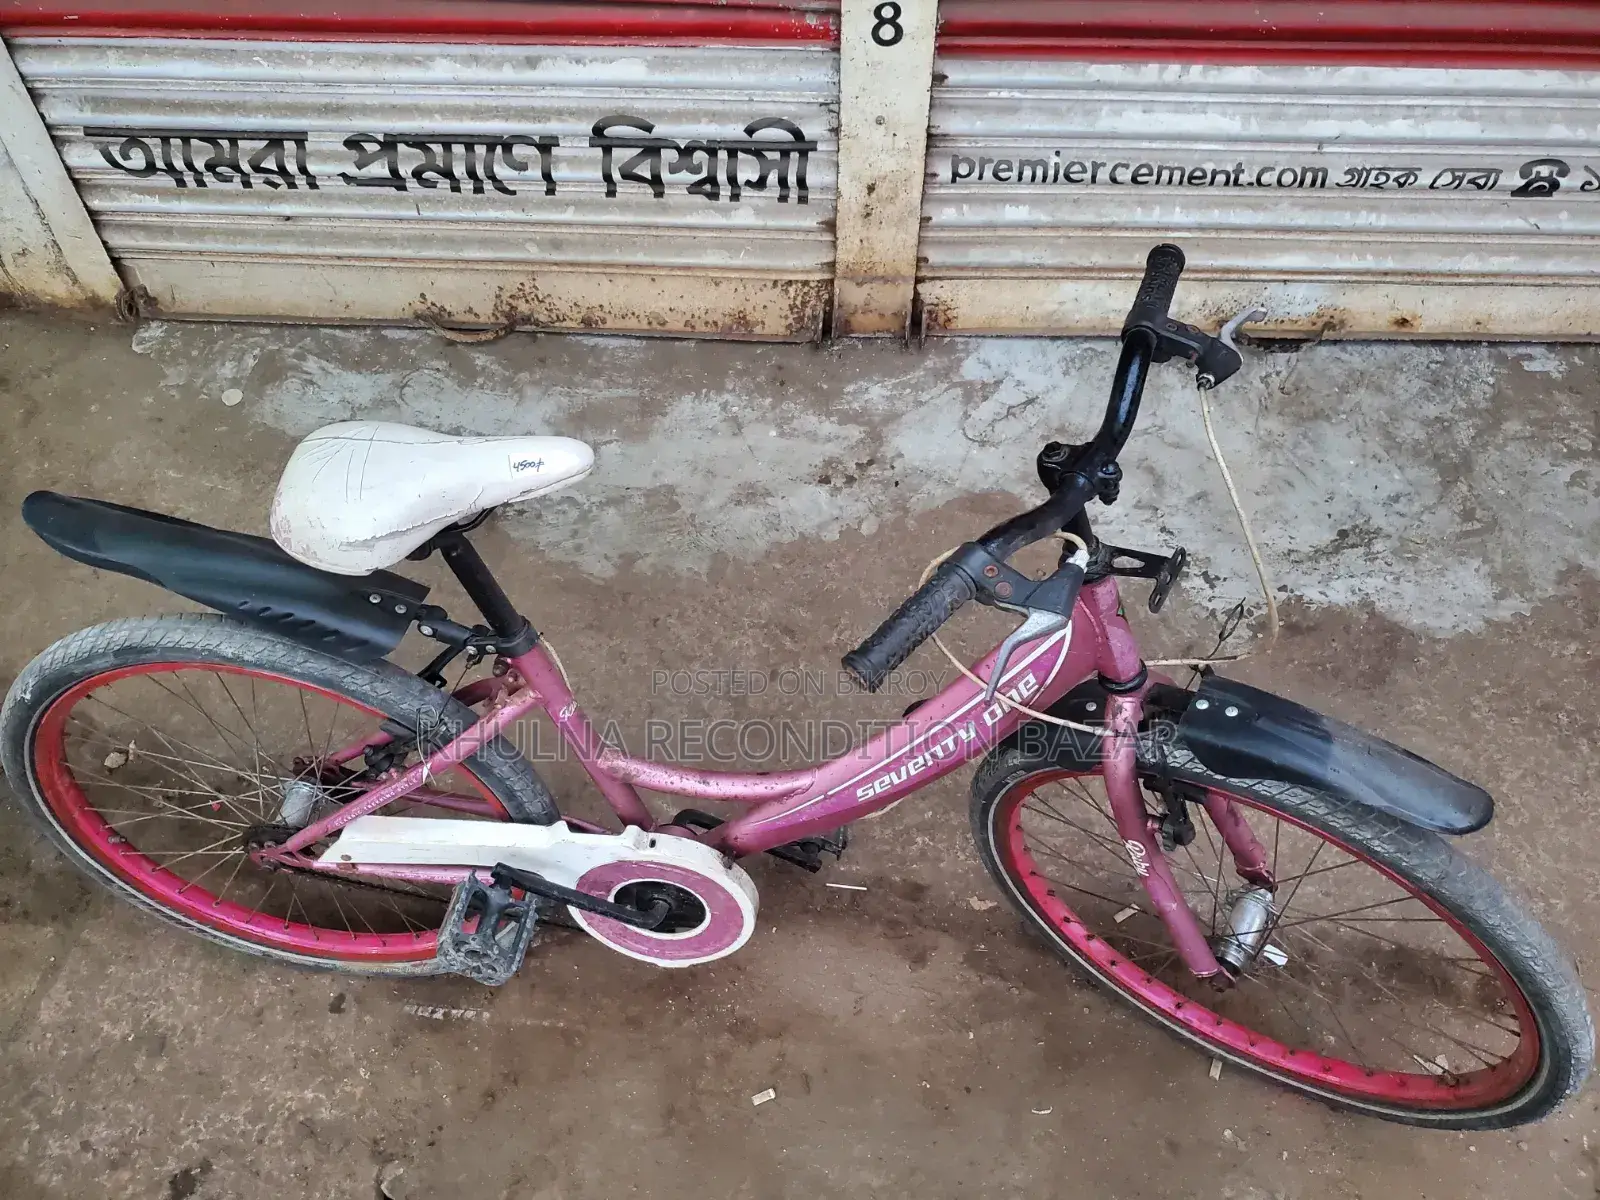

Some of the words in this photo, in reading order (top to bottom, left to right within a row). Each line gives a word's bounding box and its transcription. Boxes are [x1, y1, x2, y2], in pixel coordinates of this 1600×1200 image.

[871, 1, 904, 47] 8
[83, 126, 320, 190] আমরা
[337, 133, 561, 196] প্রমাণে
[588, 115, 818, 205] বিশ্বাসী
[950, 150, 1329, 189] premiercement.com
[1335, 166, 1423, 190] গ্রাহক
[1428, 166, 1504, 191] সেবা
